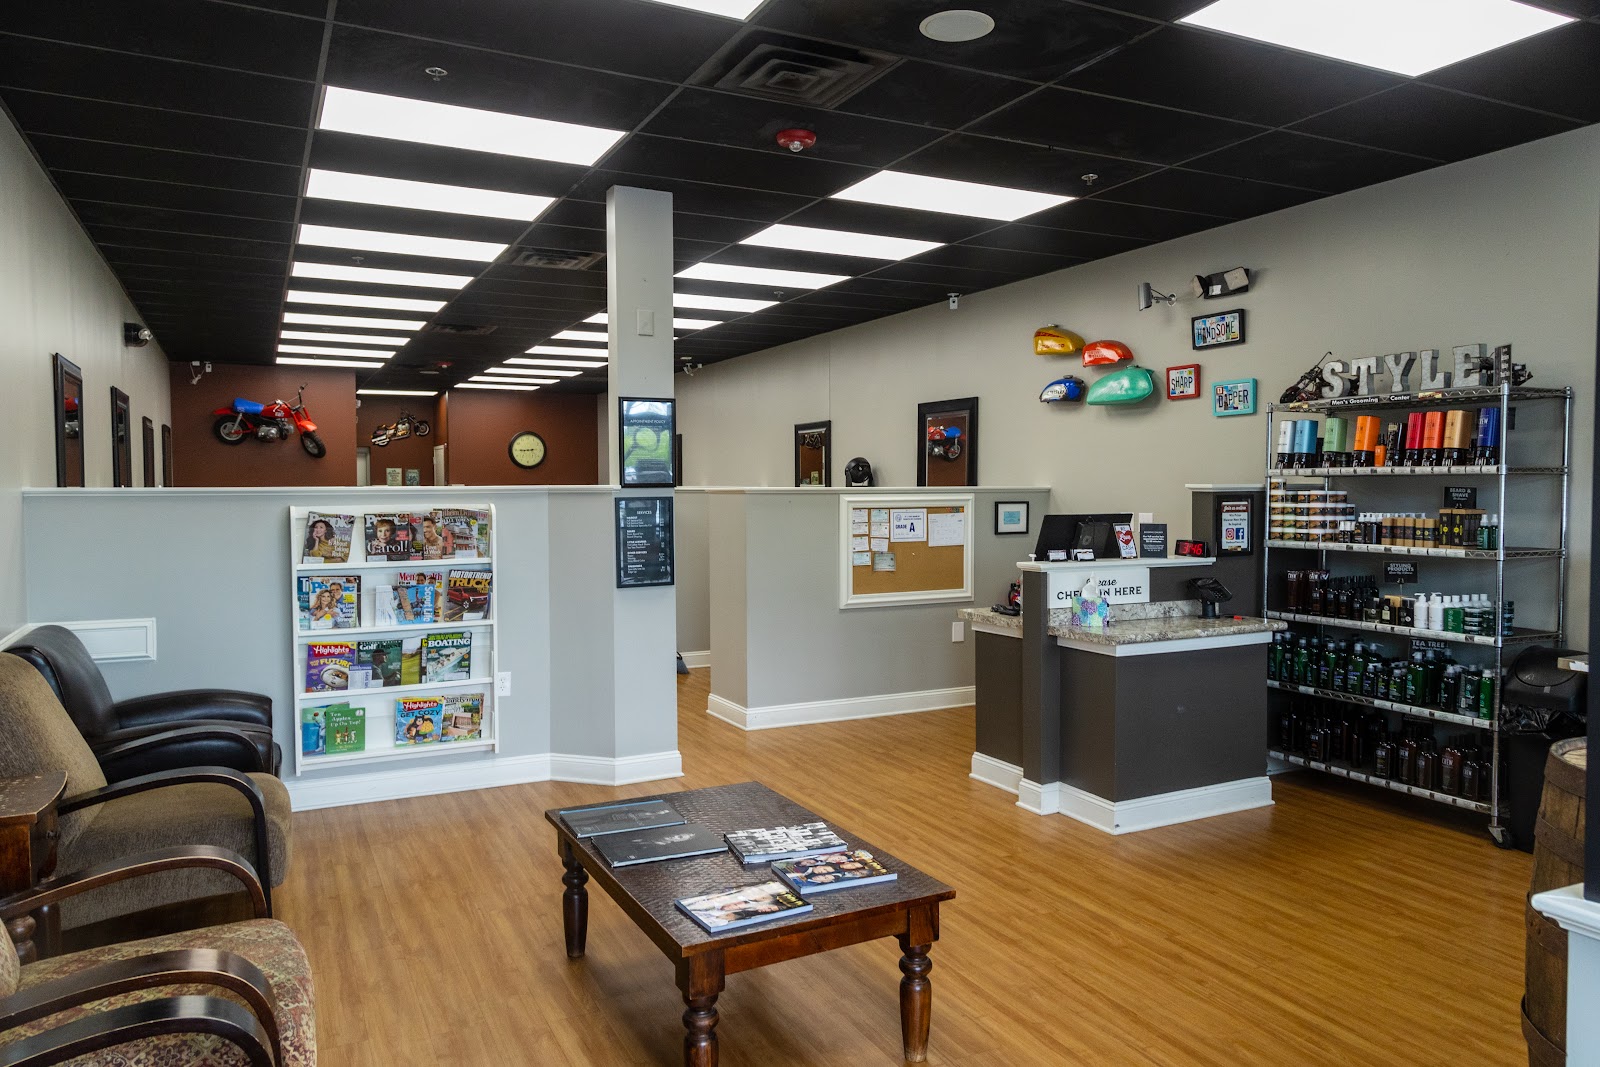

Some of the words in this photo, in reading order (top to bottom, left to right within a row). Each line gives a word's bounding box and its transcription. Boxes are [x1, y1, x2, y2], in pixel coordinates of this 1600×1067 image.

[1196, 320, 1236, 344] HANDSOME
[1321, 343, 1487, 398] STYLE
[1171, 375, 1193, 391] SHARP
[1218, 389, 1249, 411] DAPPER
[909, 522, 915, 532] A
[1182, 542, 1203, 556] 3:46
[310, 581, 356, 593] Pele
[448, 578, 491, 587] TRUCK
[423, 586, 434, 608] Scout
[1114, 586, 1142, 597] HERE
[428, 638, 471, 648] BOATING
[1411, 639, 1426, 647] TEA
[313, 644, 350, 655] Highlights
[403, 701, 439, 710] Highlights
[400, 711, 416, 719] GET
[417, 709, 441, 717] COZY
